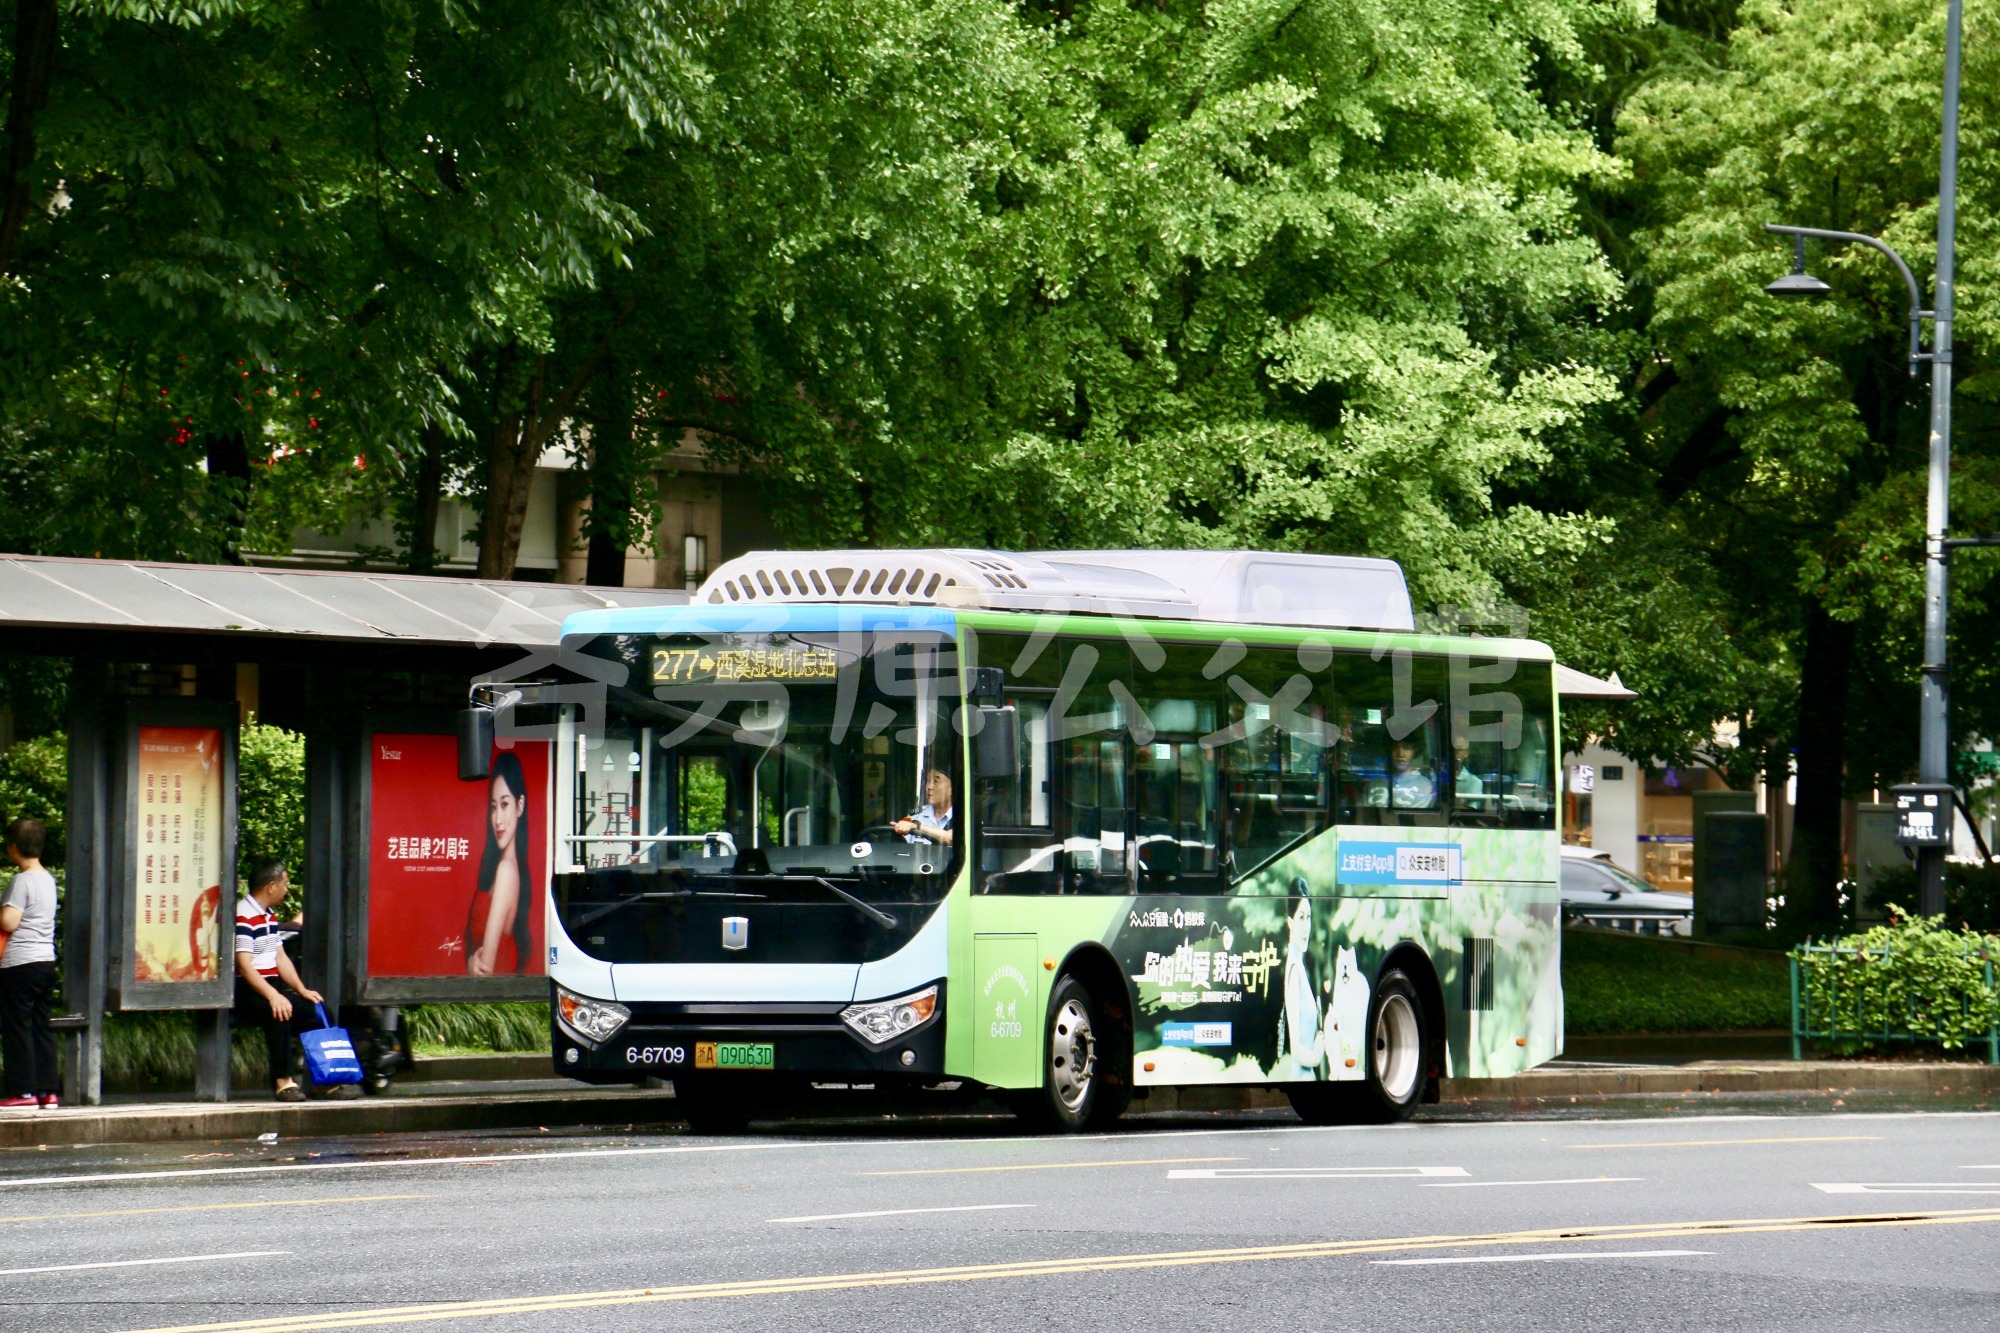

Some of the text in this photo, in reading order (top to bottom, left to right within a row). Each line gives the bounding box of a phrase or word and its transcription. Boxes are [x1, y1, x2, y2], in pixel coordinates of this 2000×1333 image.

[653, 649, 836, 680] 277 西溪湿地北总站
[380, 746, 402, 760] Yestar
[388, 837, 469, 861] 艺星品牌21周年
[1341, 853, 1446, 874] 上支付宝App搜 众安宠物险
[1130, 935, 1281, 998] 你的热爱 我来守护
[995, 998, 1016, 1021] 杭州
[991, 1021, 1022, 1038] 6-6709
[626, 1047, 685, 1064] 6-6709
